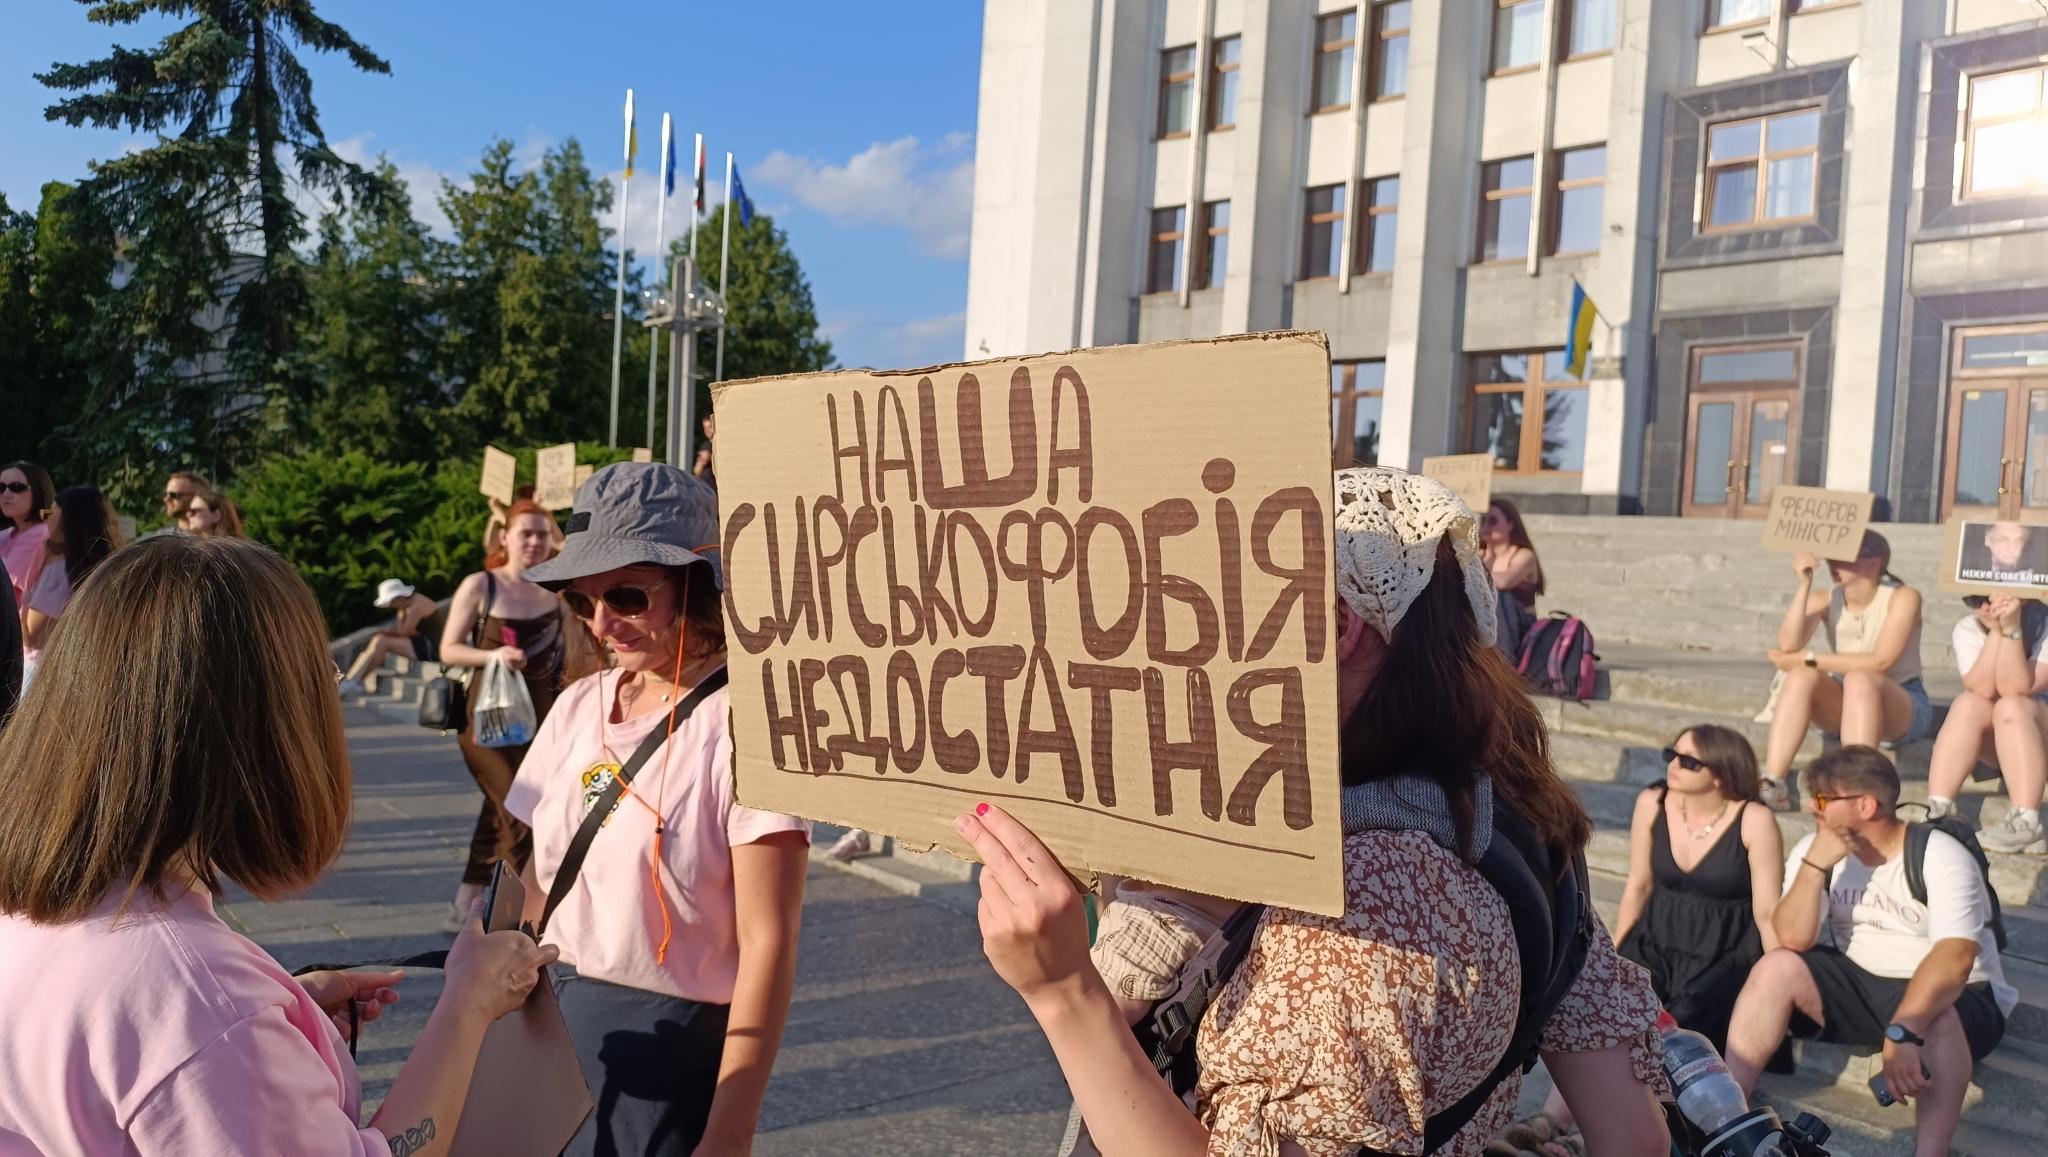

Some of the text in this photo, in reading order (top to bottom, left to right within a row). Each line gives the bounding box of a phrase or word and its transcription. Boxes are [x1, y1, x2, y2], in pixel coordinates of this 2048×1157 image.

[827, 365, 1093, 510] НАША
[1774, 518, 1850, 545] МІНІСТР
[1780, 496, 1858, 524] ФЕДОРОВ
[722, 458, 1326, 668] СИРСЬКОФОБІЯ
[761, 643, 1314, 830] НЕДОСТАТНЯ
[1832, 888, 1920, 923] MILANO
